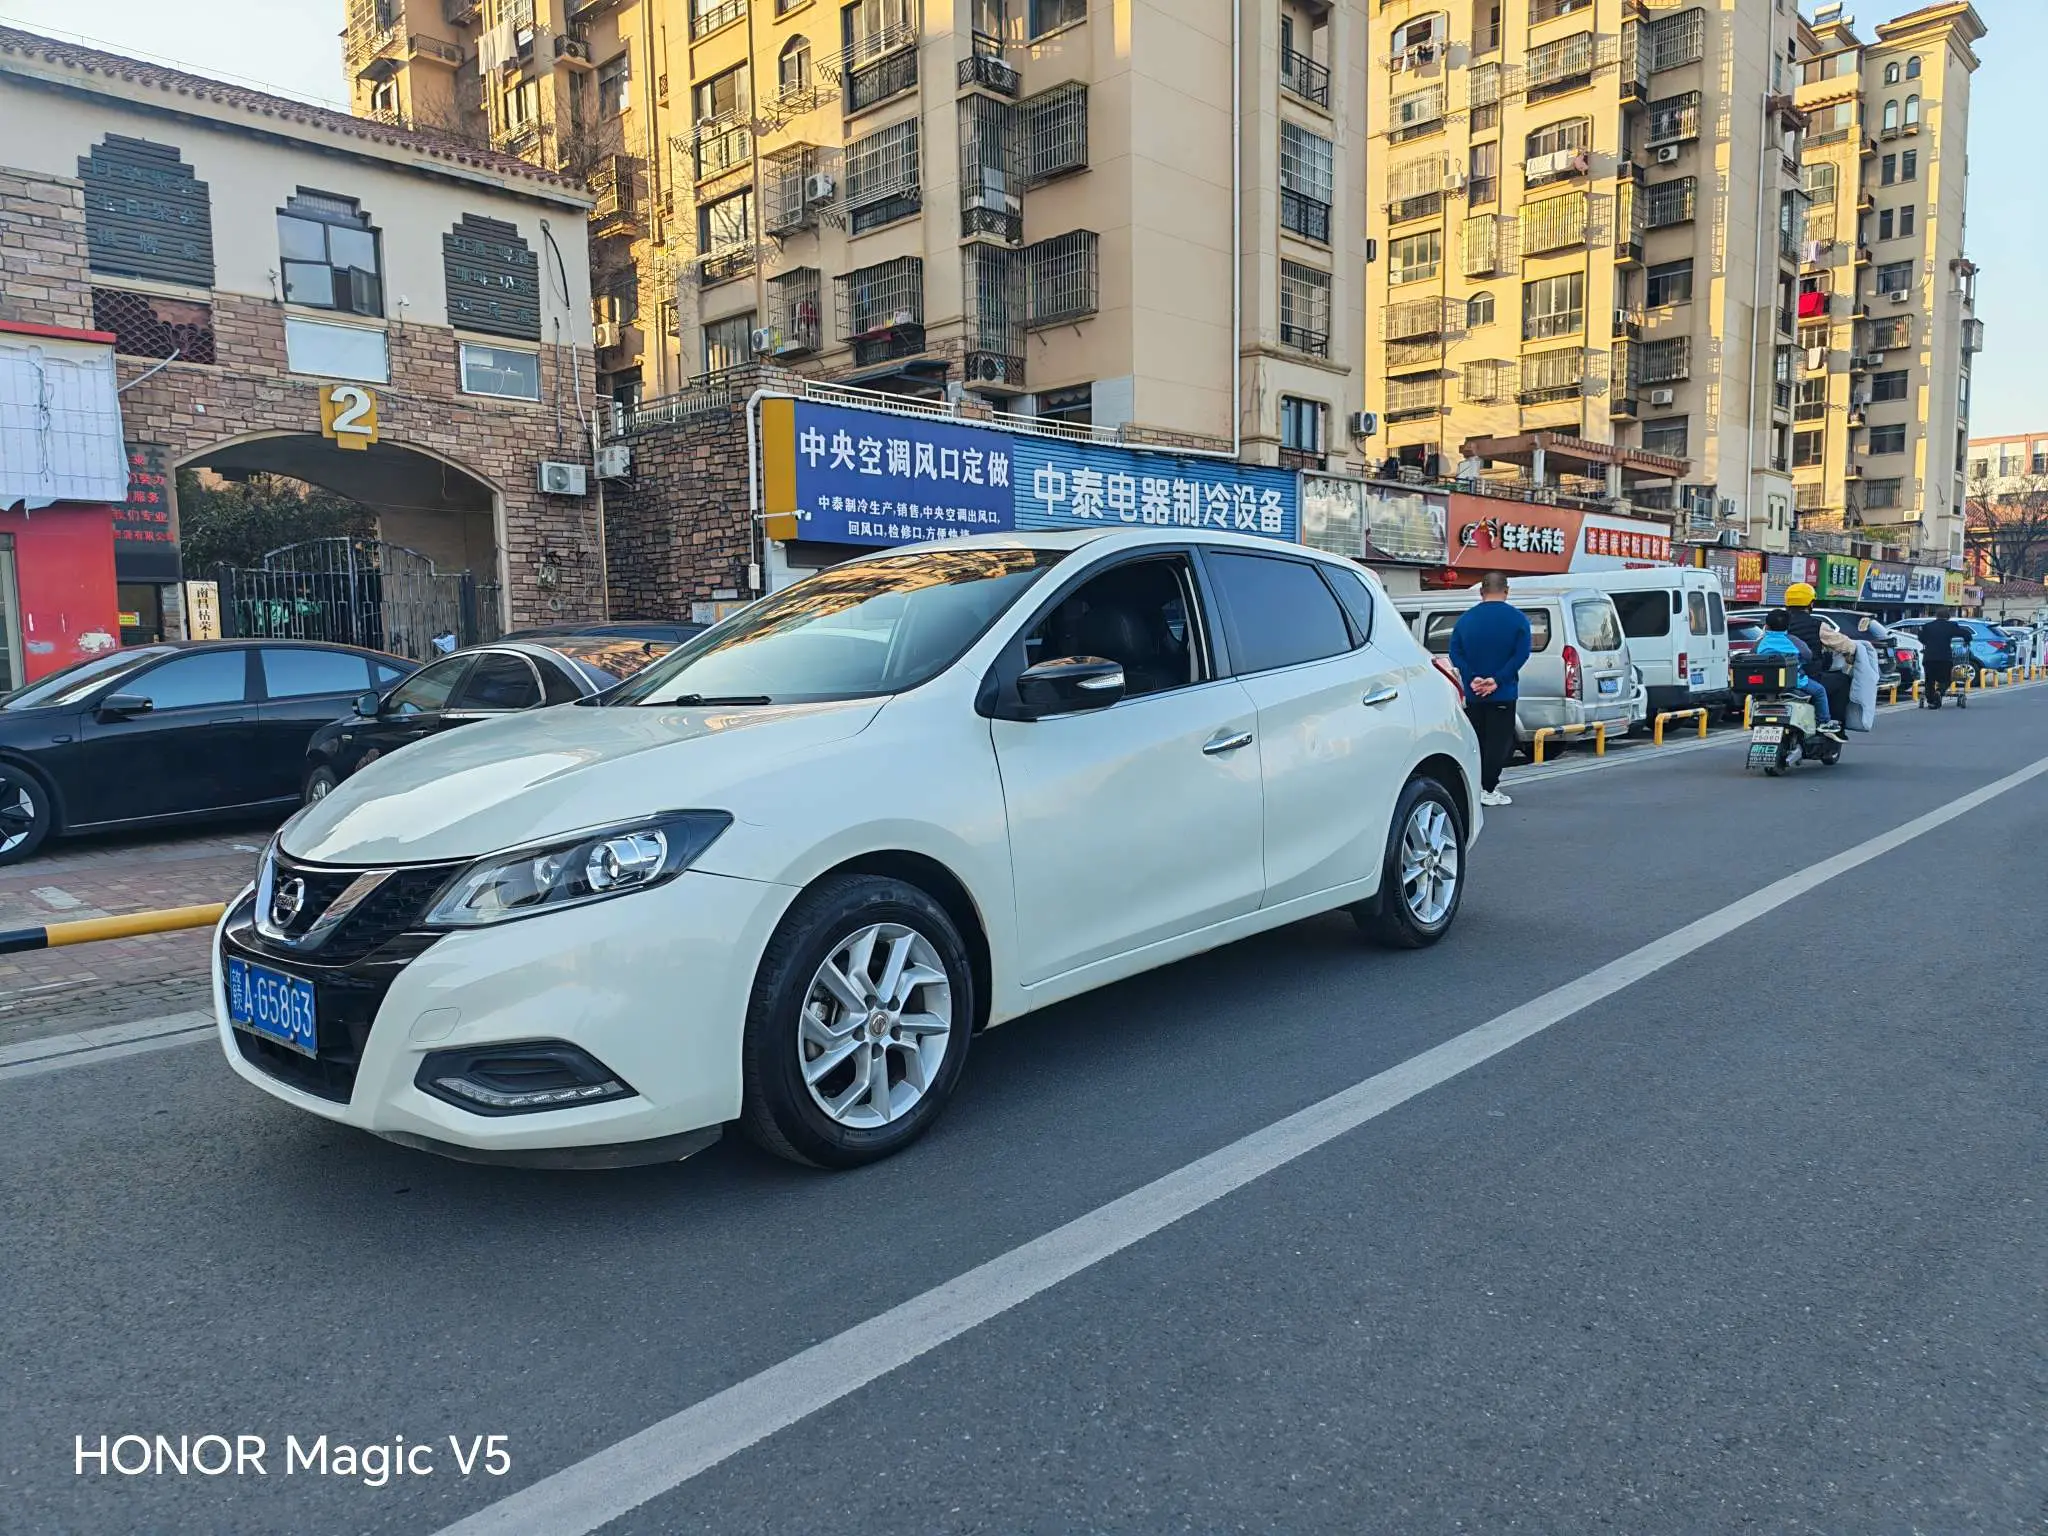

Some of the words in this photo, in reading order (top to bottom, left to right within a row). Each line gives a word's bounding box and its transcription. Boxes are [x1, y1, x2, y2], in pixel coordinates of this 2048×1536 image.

[331, 386, 373, 435] 2
[800, 426, 1010, 488] 中央空调风口定做
[1033, 461, 1285, 533] 中泰电器制冷设备
[1502, 522, 1565, 554] 车老大养车
